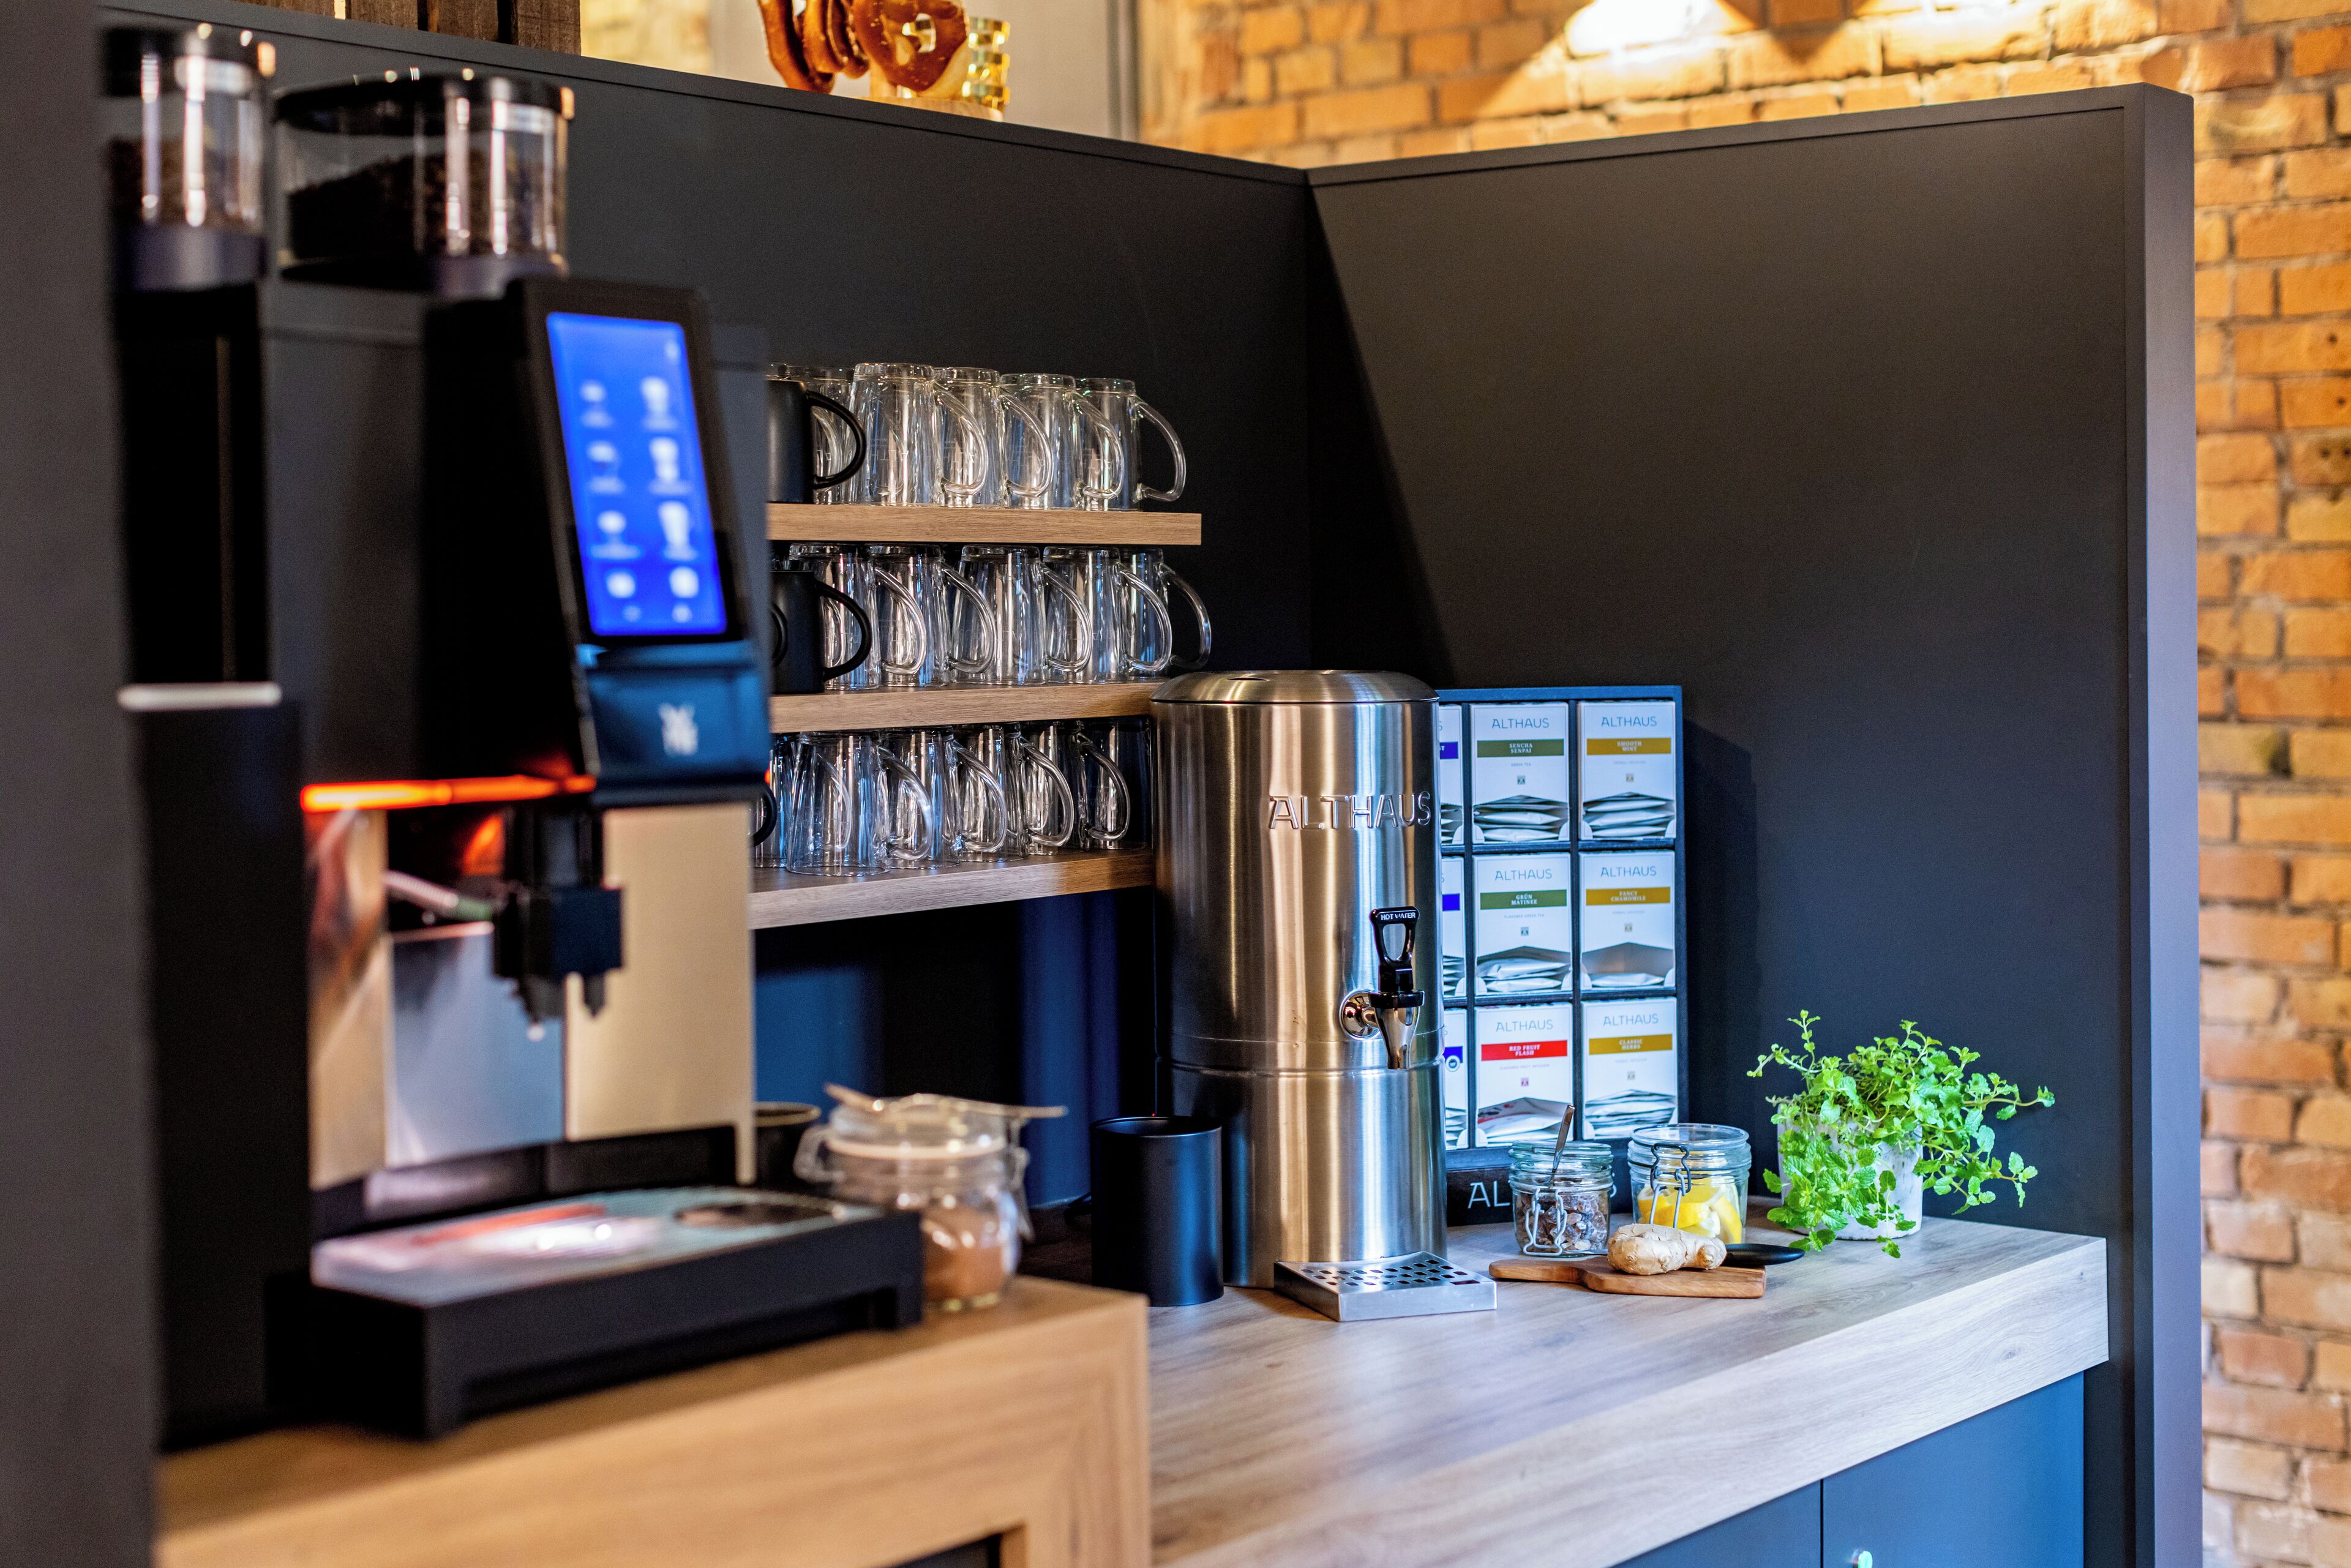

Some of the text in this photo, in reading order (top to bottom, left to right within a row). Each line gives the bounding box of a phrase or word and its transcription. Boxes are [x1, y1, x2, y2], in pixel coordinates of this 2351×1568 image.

[1491, 718, 1550, 729] ALTHAUS
[1601, 716, 1657, 727] ALTHAUS
[1269, 790, 1431, 829] ALTHAUS
[1494, 868, 1553, 881] ALTHAUS
[1600, 866, 1657, 877] ALTHAUS
[1496, 1019, 1553, 1032] ALTHAUS
[1603, 1013, 1659, 1027] ALTHAUS
[1468, 1180, 1510, 1209] AL
